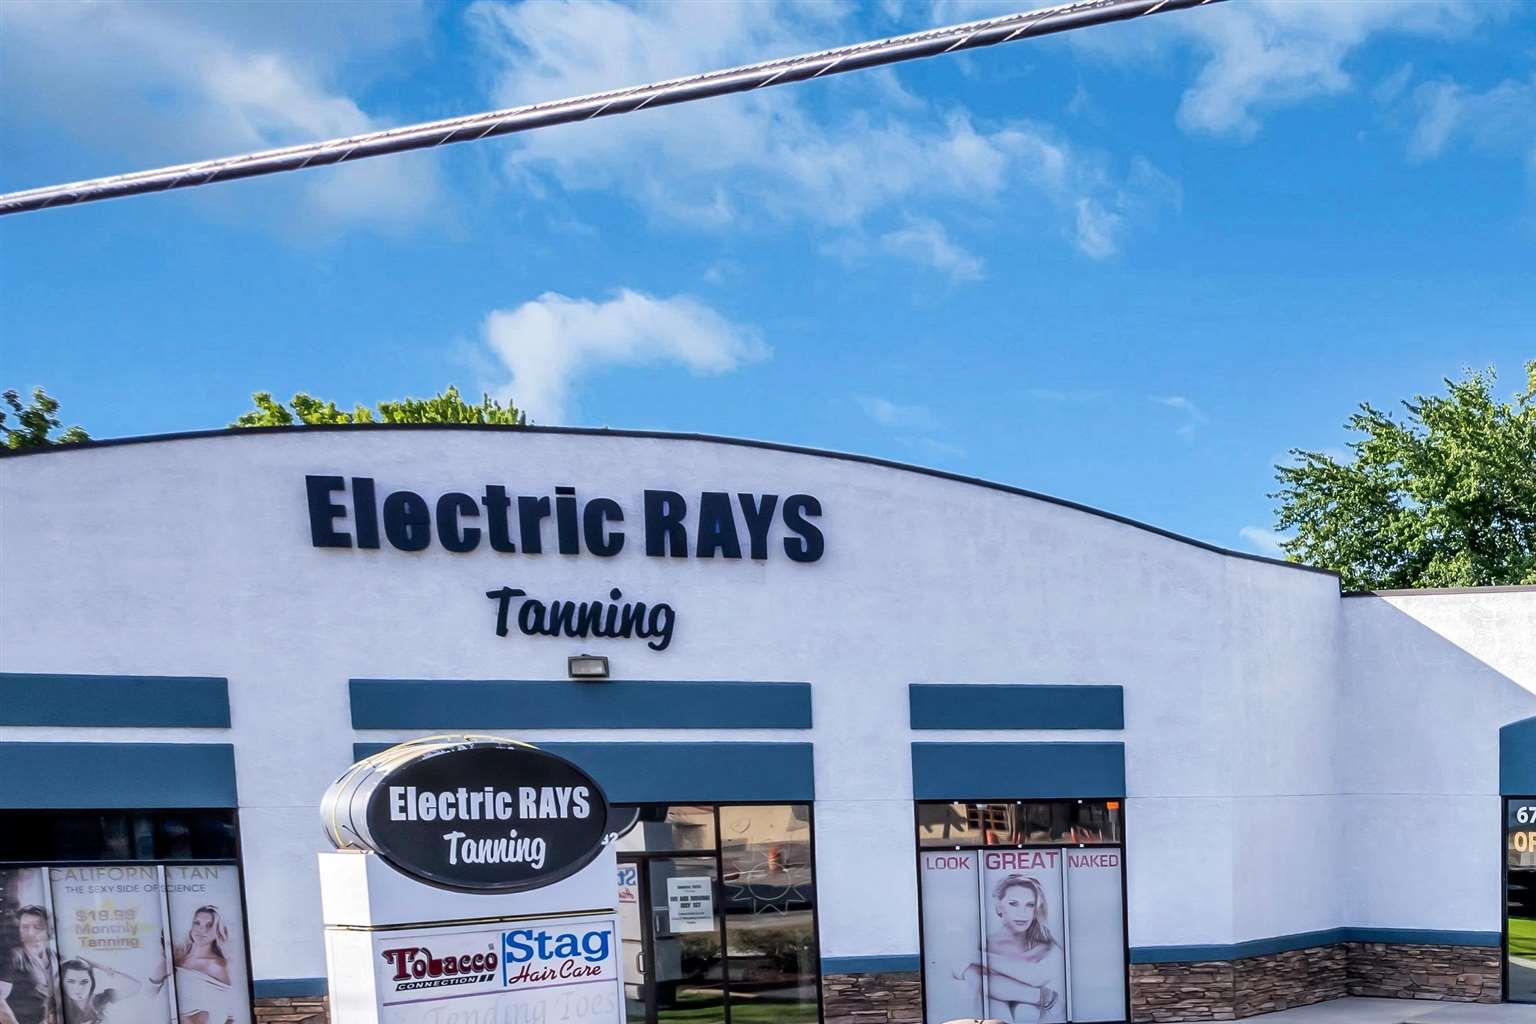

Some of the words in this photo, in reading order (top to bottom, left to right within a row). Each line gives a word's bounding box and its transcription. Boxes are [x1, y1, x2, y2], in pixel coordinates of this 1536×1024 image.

[305, 474, 625, 557] Electric
[644, 489, 825, 563] RAYS
[486, 586, 676, 652] Tanning
[389, 786, 512, 821] Electric
[518, 785, 591, 820] RAYS
[443, 828, 546, 869] Tanning
[926, 857, 970, 870] LOOK
[985, 851, 1059, 870] GREAT
[1068, 854, 1119, 868] NAKED
[65, 885, 84, 894] THE
[88, 885, 114, 893] SEXY
[116, 884, 140, 893] SIDE
[178, 866, 218, 880] TAN
[506, 928, 612, 963] Stag
[381, 947, 498, 982] Tobacco
[509, 965, 557, 984] Hair
[559, 959, 602, 980] Care
[398, 976, 478, 991] CONNECTION
